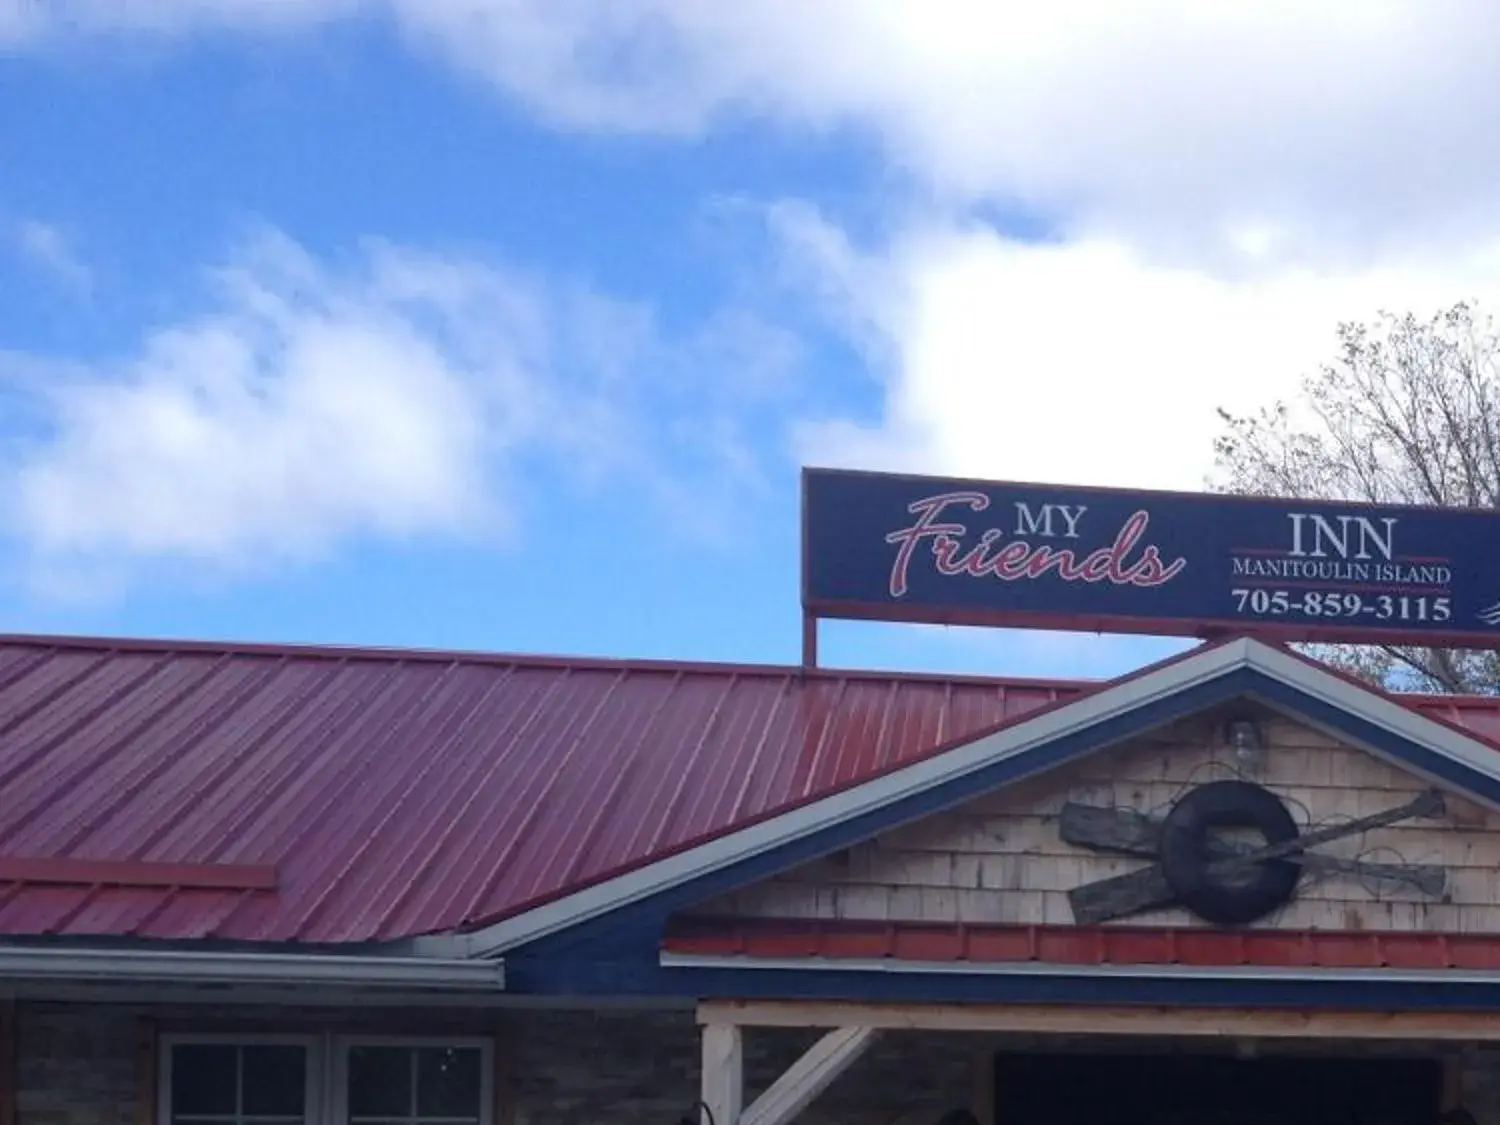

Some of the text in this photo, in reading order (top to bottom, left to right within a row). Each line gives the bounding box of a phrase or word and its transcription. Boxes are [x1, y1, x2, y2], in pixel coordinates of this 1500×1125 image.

[1013, 501, 1088, 538] MY
[1286, 513, 1399, 560] INN
[885, 491, 1187, 597] Friends
[1231, 557, 1451, 585] MANITOULIN ISLAND
[1231, 588, 1451, 622] 705-859-3115
